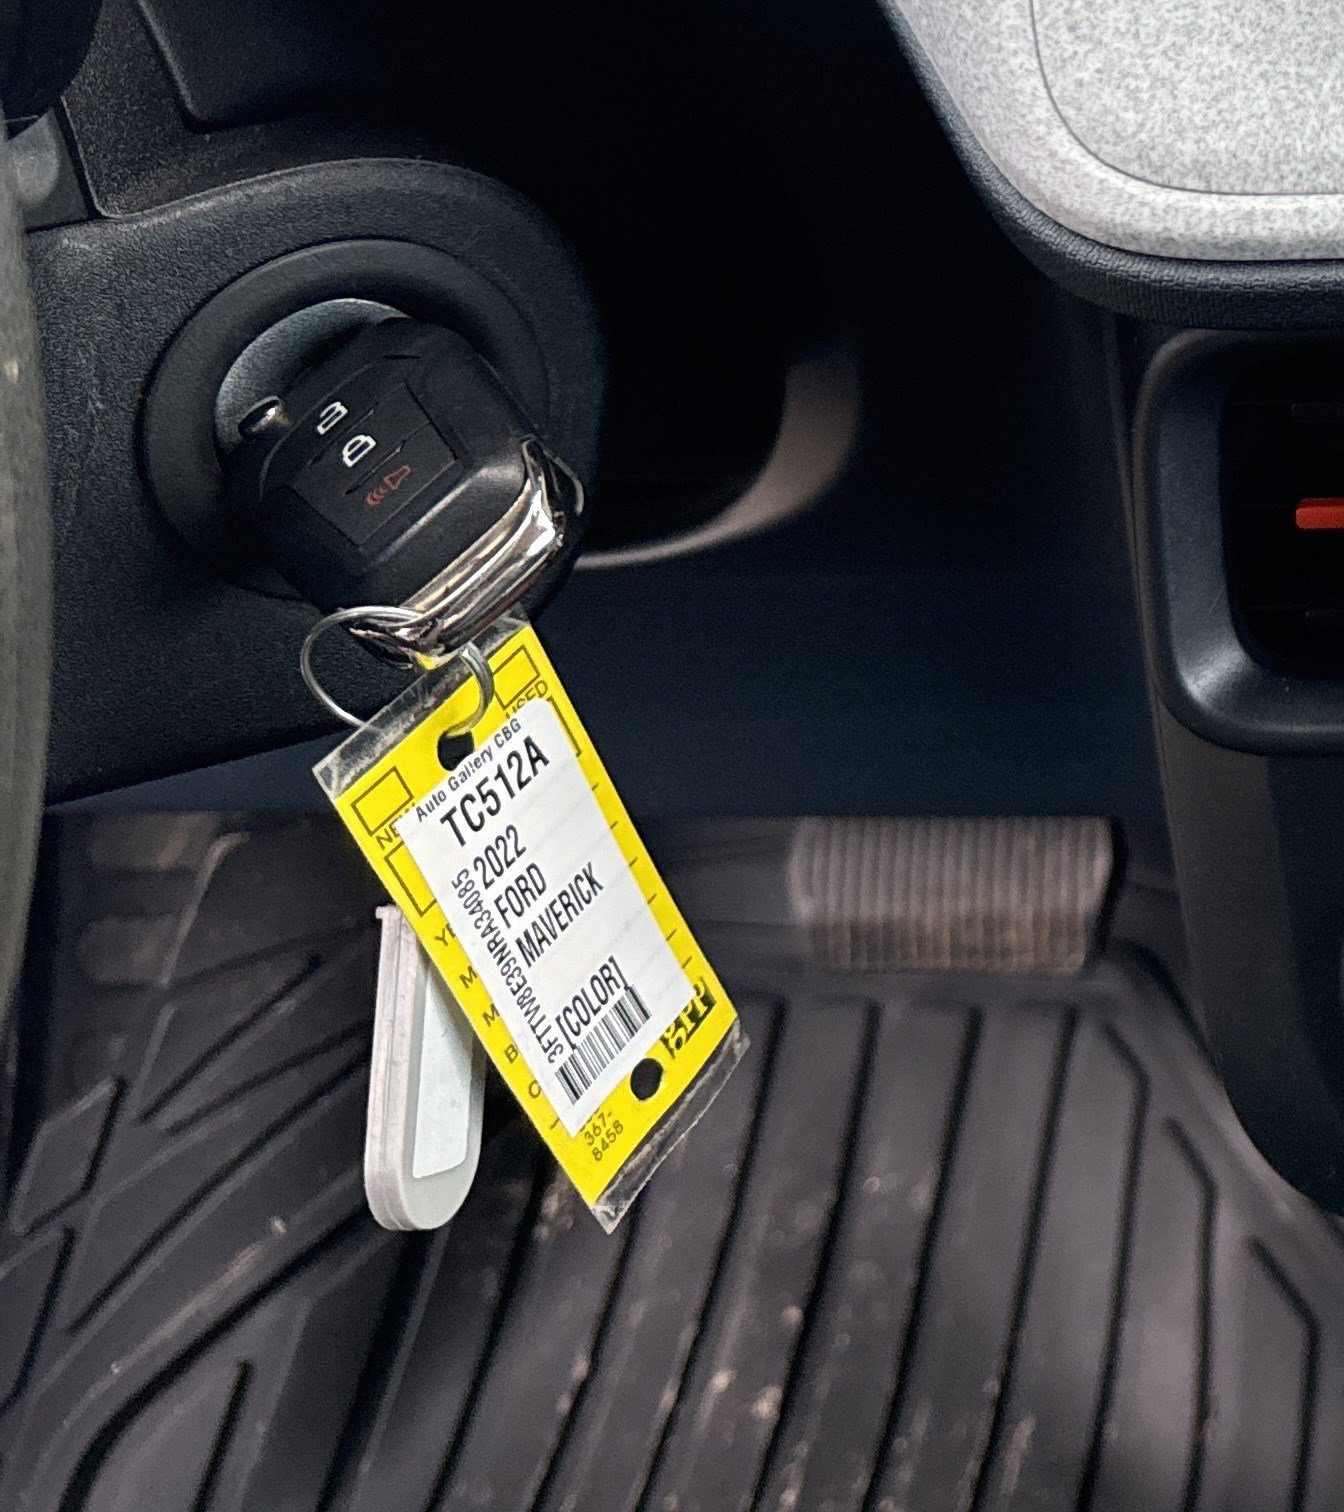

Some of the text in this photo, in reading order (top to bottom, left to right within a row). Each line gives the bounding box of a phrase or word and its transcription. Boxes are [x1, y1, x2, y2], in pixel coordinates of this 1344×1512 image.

[415, 718, 522, 822] Auto Gallery CBG
[439, 736, 550, 847] TC512A
[473, 824, 527, 890] 2022
[494, 862, 547, 929] FORD
[515, 861, 604, 968] MAVERICK
[555, 955, 633, 1049] [COLOR]
[592, 1119, 625, 1162] 8458
